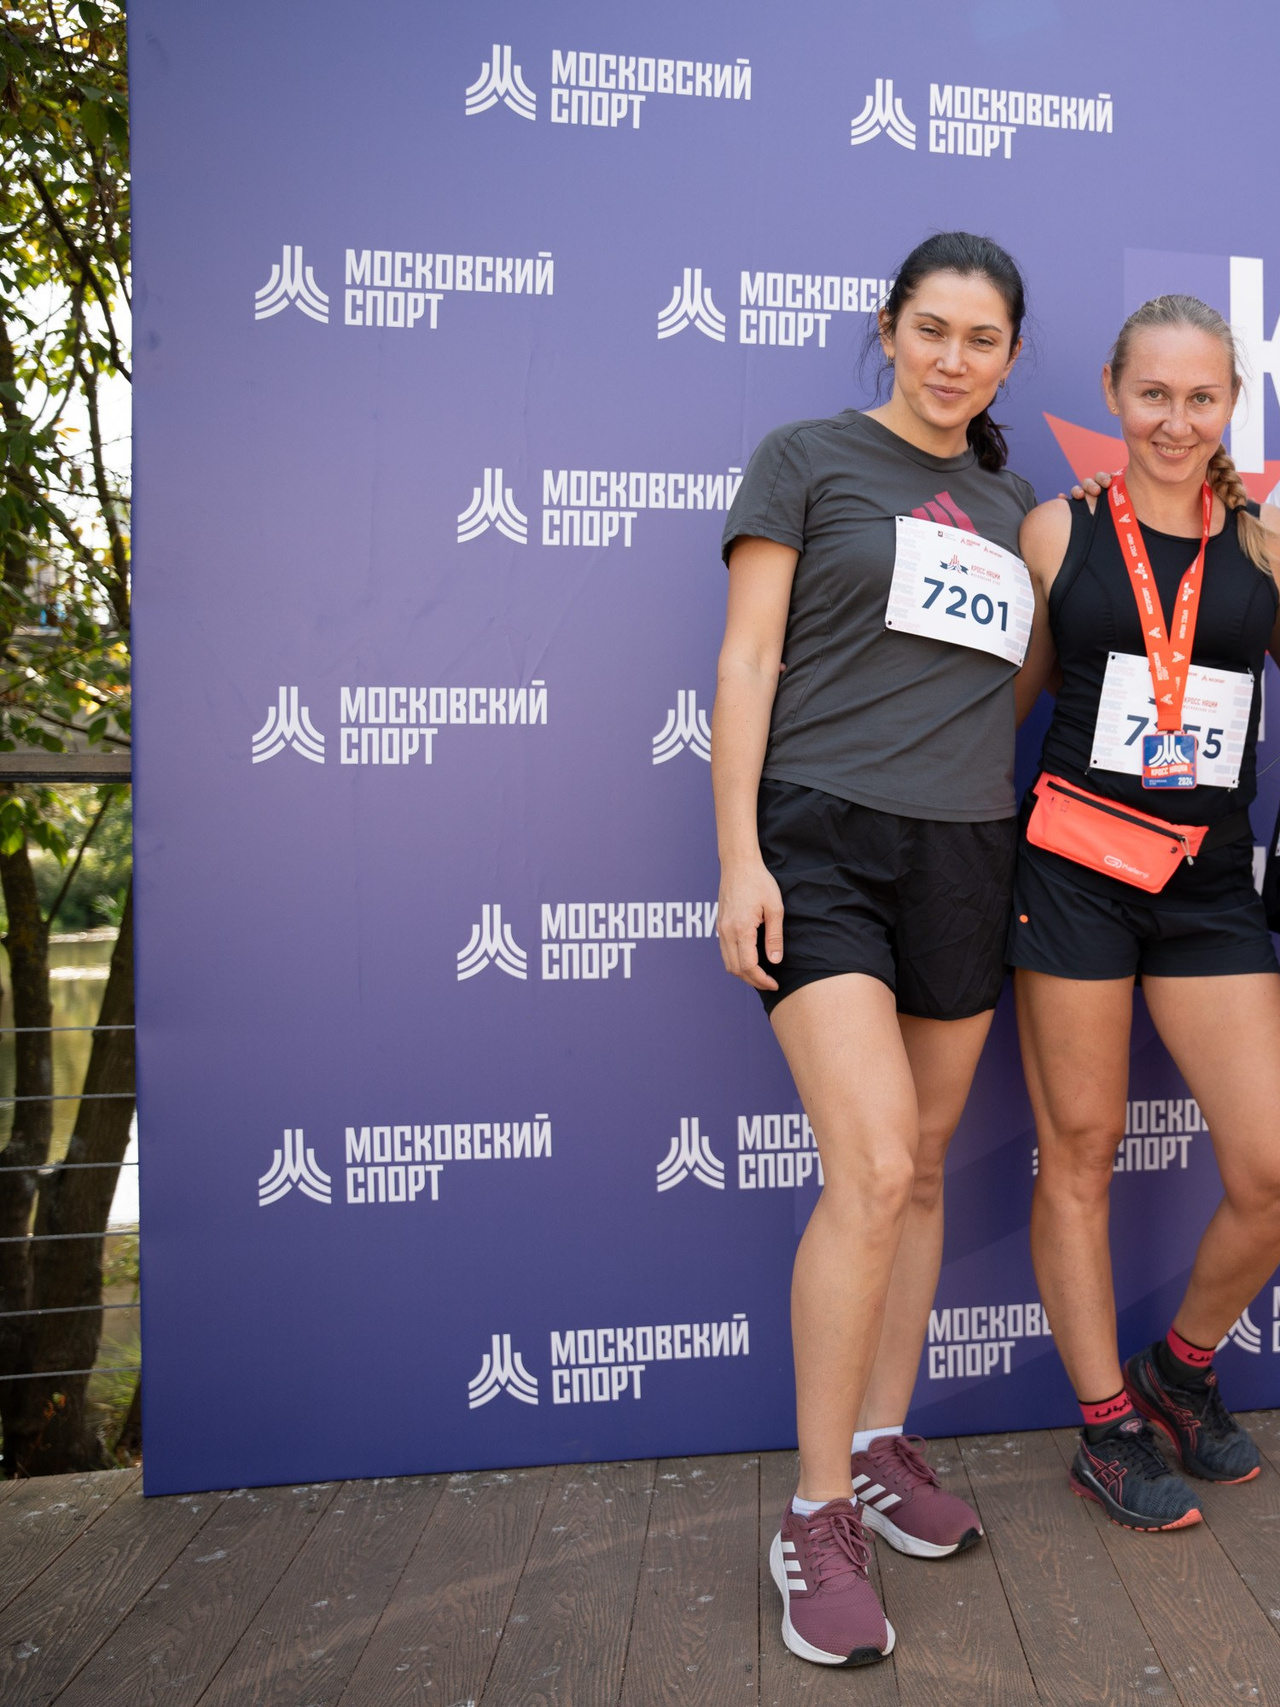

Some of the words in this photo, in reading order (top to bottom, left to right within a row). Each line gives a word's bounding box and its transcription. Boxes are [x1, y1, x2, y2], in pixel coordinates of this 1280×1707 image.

[552, 50, 751, 100] МОСКОВСКИЙ
[551, 88, 645, 129] СПОРТ
[930, 84, 1112, 133] МОСКОВСКИЙ
[930, 120, 1016, 159] СПОРТ
[346, 249, 554, 295] МОСКОВСКИЙ
[345, 289, 443, 329] СПОРТ
[740, 309, 831, 347] СПОРТ
[542, 509, 638, 547] СПОРТ
[922, 577, 1008, 632] 7201
[341, 680, 547, 724] МОСКОВСКИЙ
[341, 728, 438, 764] СПОРТ
[542, 942, 636, 980] СПОРТ
[1124, 1098, 1209, 1134] ОСКО
[346, 1114, 551, 1163] МОСКОВСКИЙ
[347, 1165, 443, 1203] СПОРТ
[738, 1151, 824, 1190] СПОРТ
[551, 1314, 749, 1366] МОСКОВСКИЙ
[929, 1341, 1016, 1379] СПОРТ
[552, 1365, 645, 1404] СПОРТ
